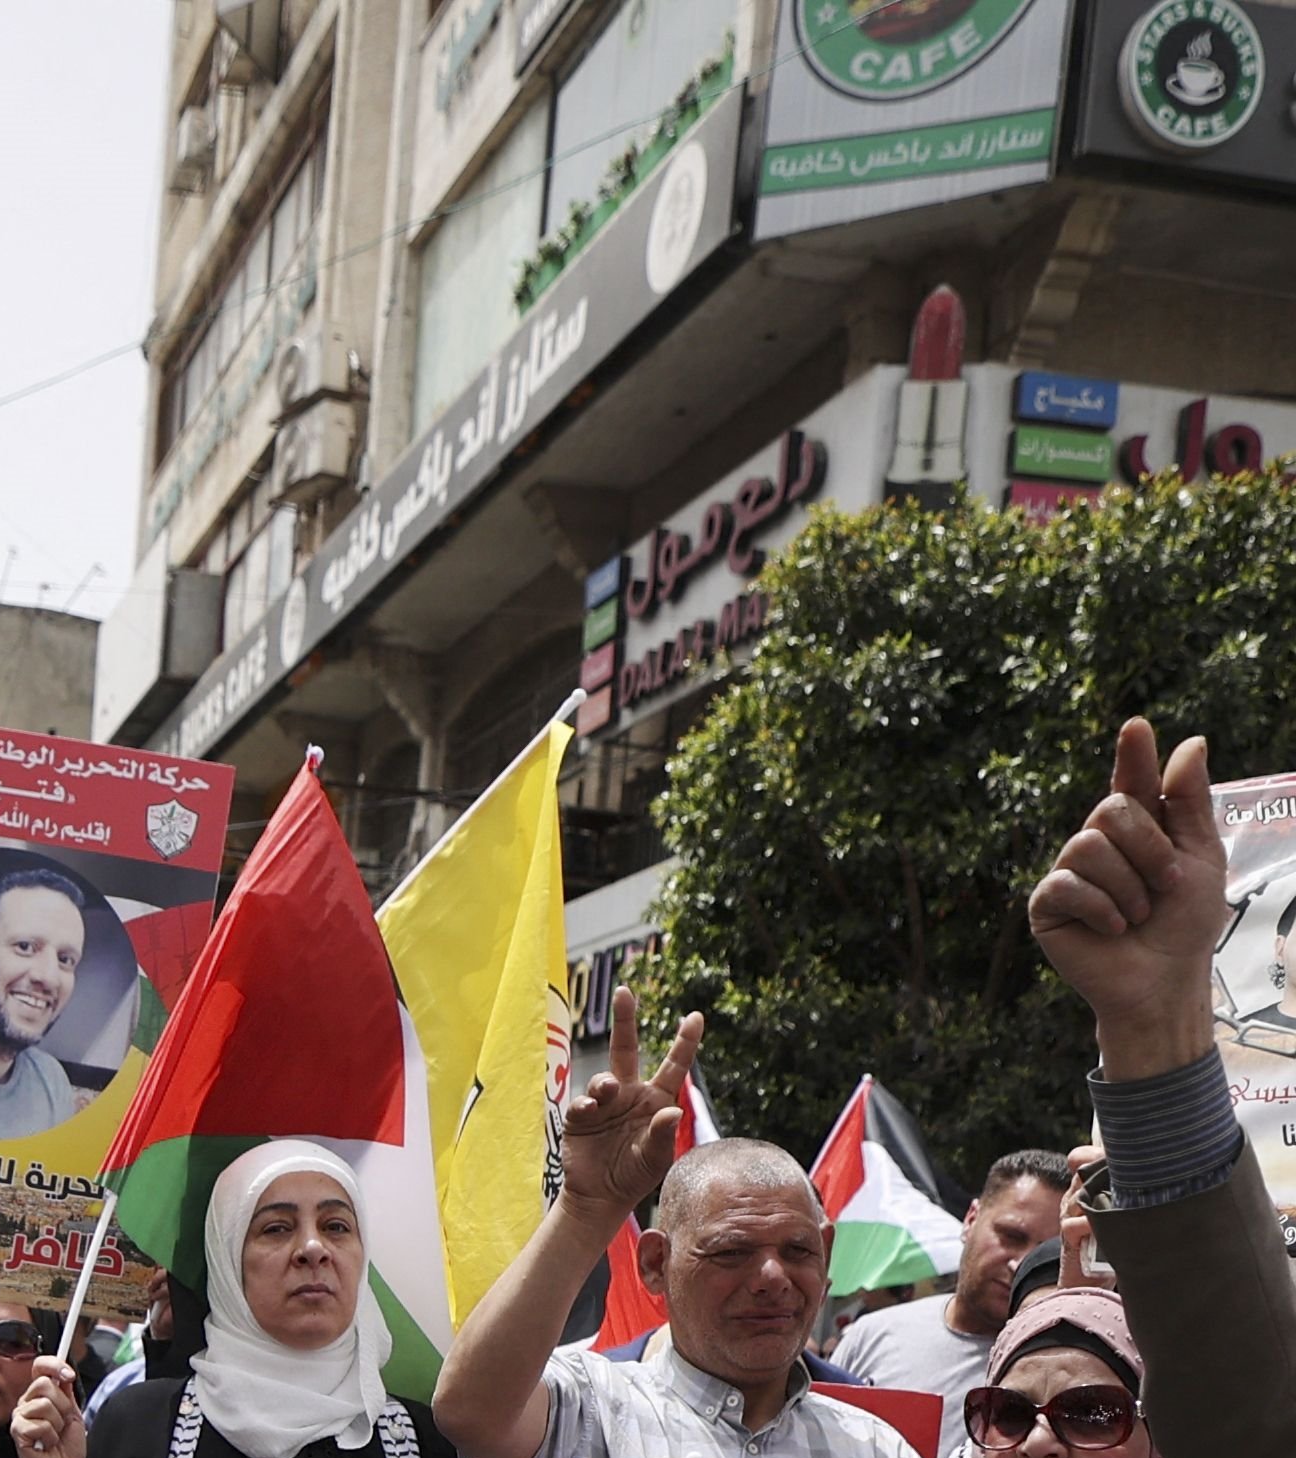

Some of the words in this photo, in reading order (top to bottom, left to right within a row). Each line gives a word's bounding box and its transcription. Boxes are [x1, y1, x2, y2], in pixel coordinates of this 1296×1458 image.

[849, 20, 983, 84] CAFE
[1158, 105, 1228, 137] CAFE
[59, 752, 145, 782] التحرير
[148, 761, 210, 793] حركة
[31, 816, 59, 839] رام
[60, 822, 112, 846] إقليم
[25, 1161, 106, 1201] حرية
